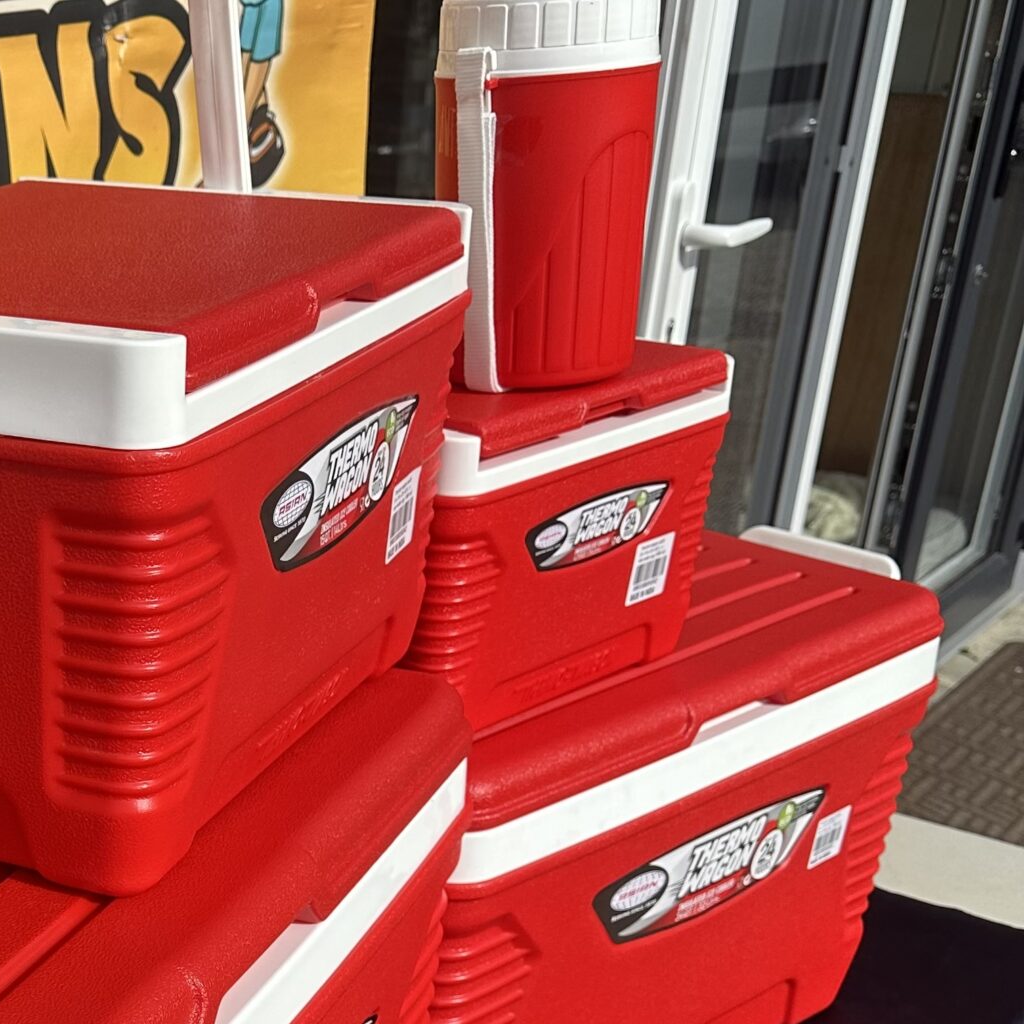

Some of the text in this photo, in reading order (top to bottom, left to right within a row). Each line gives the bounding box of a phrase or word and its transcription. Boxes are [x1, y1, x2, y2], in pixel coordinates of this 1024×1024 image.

[329, 421, 379, 483] THERMO
[278, 490, 308, 517] ASIAN
[321, 452, 373, 517] WAGON
[580, 497, 629, 527] THERMO
[574, 513, 623, 545] WAGON
[689, 815, 768, 870] THERMO
[678, 844, 757, 899] WAGON
